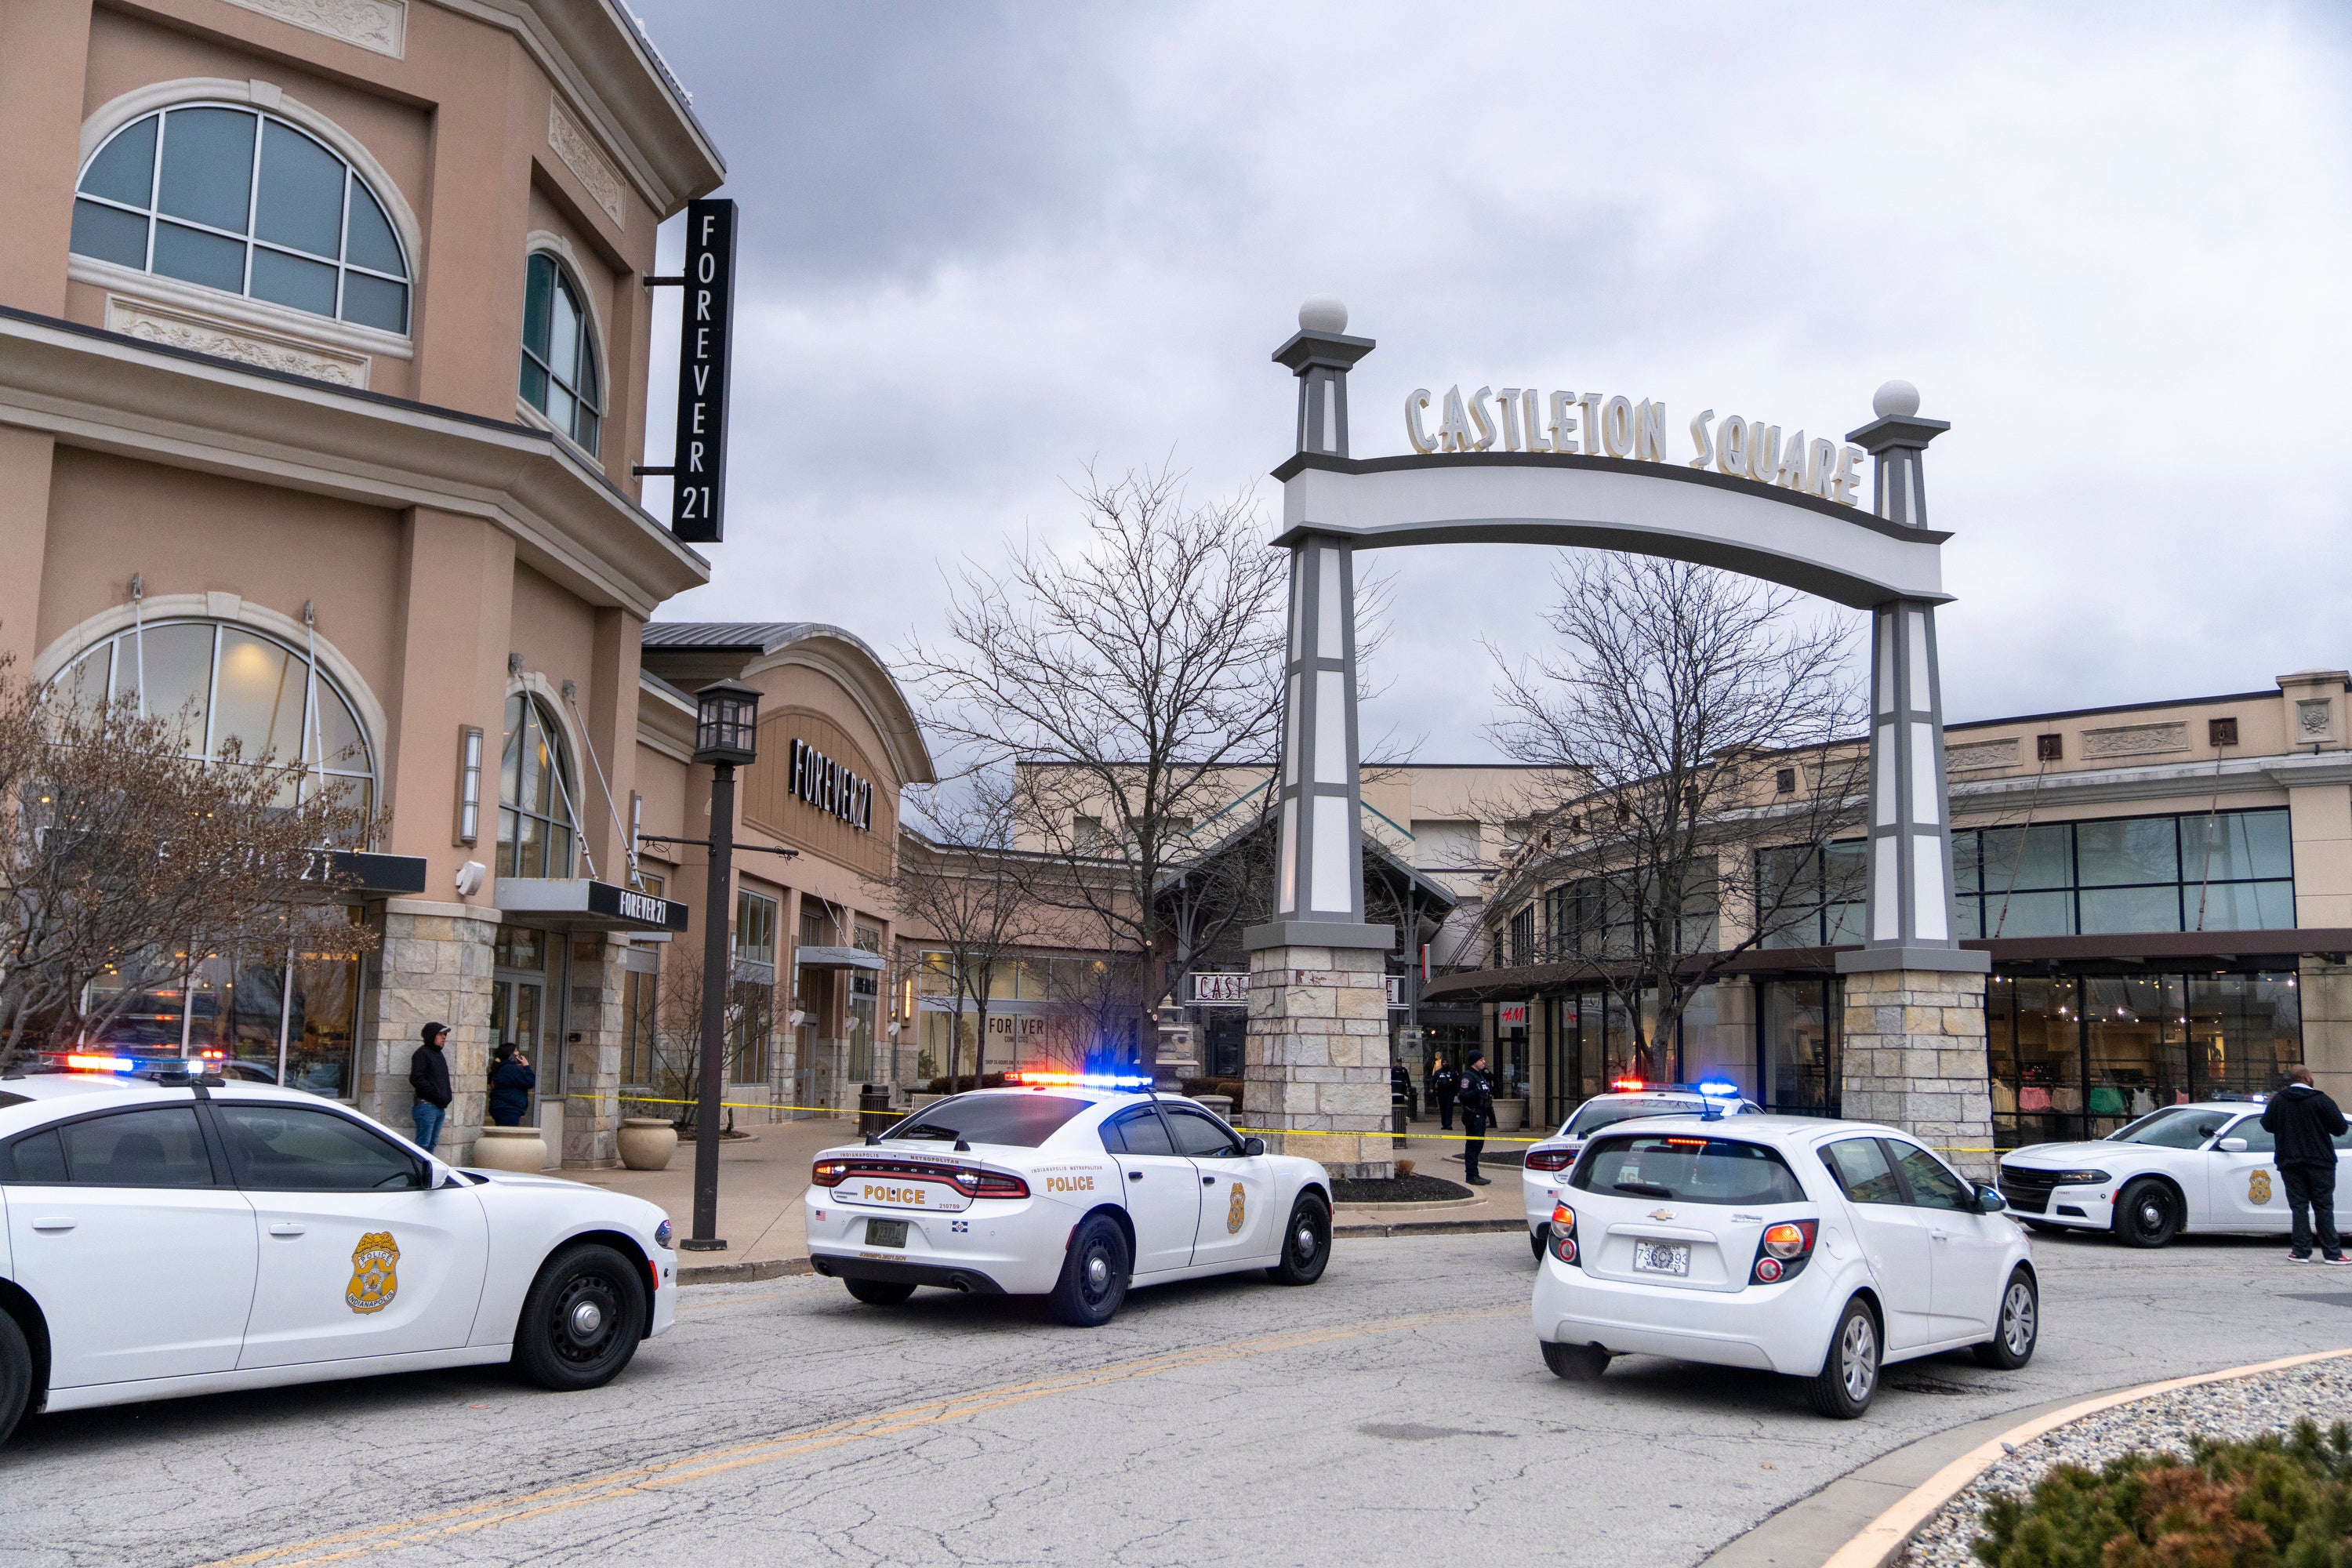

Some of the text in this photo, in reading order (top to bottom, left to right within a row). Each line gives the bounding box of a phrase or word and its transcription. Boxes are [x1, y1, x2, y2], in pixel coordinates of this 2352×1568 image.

[688, 215, 716, 473] FOREVER
[1404, 383, 1864, 506] CASTLETON SQUARE
[681, 486, 710, 519] 21
[790, 738, 873, 831] FOREVER 21
[619, 891, 666, 924] FOREVER 21
[1501, 1007, 1524, 1022] H&M
[989, 1018, 1044, 1034] FORVER
[861, 1164, 935, 1174] DODGE
[909, 1155, 960, 1165] METROPOLITAN
[1046, 1176, 1094, 1192] POLICE
[864, 1185, 926, 1205] POLICE
[360, 1251, 393, 1264] POLICE
[348, 1290, 394, 1308] INDIANAPOLIS
